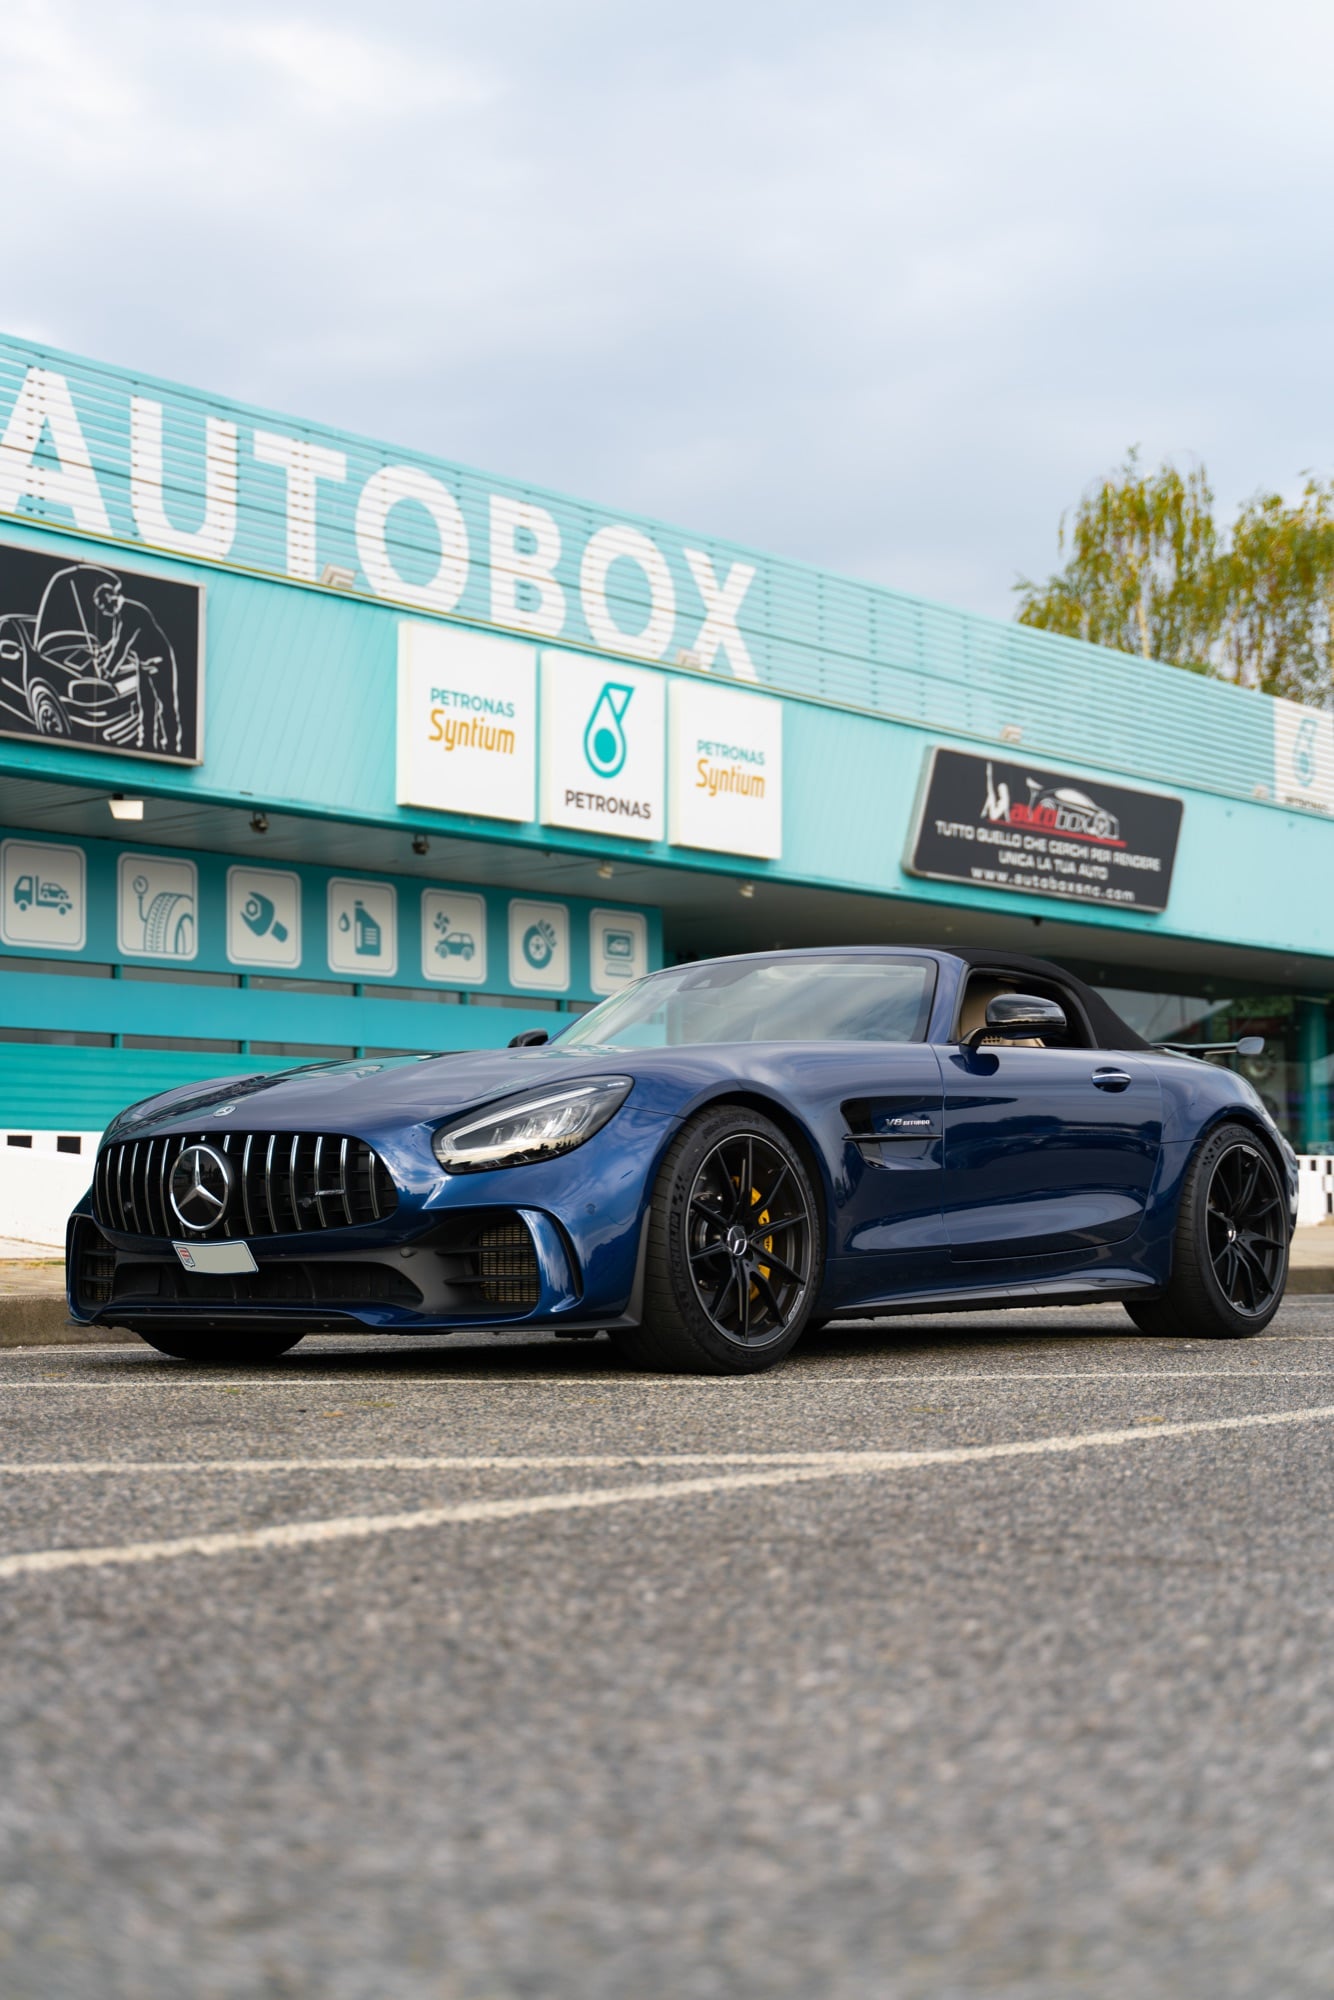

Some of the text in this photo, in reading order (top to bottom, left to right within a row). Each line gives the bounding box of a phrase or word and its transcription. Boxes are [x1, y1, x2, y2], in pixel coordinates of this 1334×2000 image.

[0, 366, 760, 683] AUTOBOX
[430, 687, 515, 718] PETRONAS
[428, 708, 516, 755] Syntium
[696, 739, 765, 766] PETRONAS
[695, 758, 765, 799] Syntium
[564, 789, 652, 820] PETRONAS
[934, 820, 1162, 872] TUTTO QUELLO CHE CERCHI PER RENDERE
[998, 850, 1109, 881] UNICA LA TUA AUTO
[885, 1118, 903, 1126] V8
